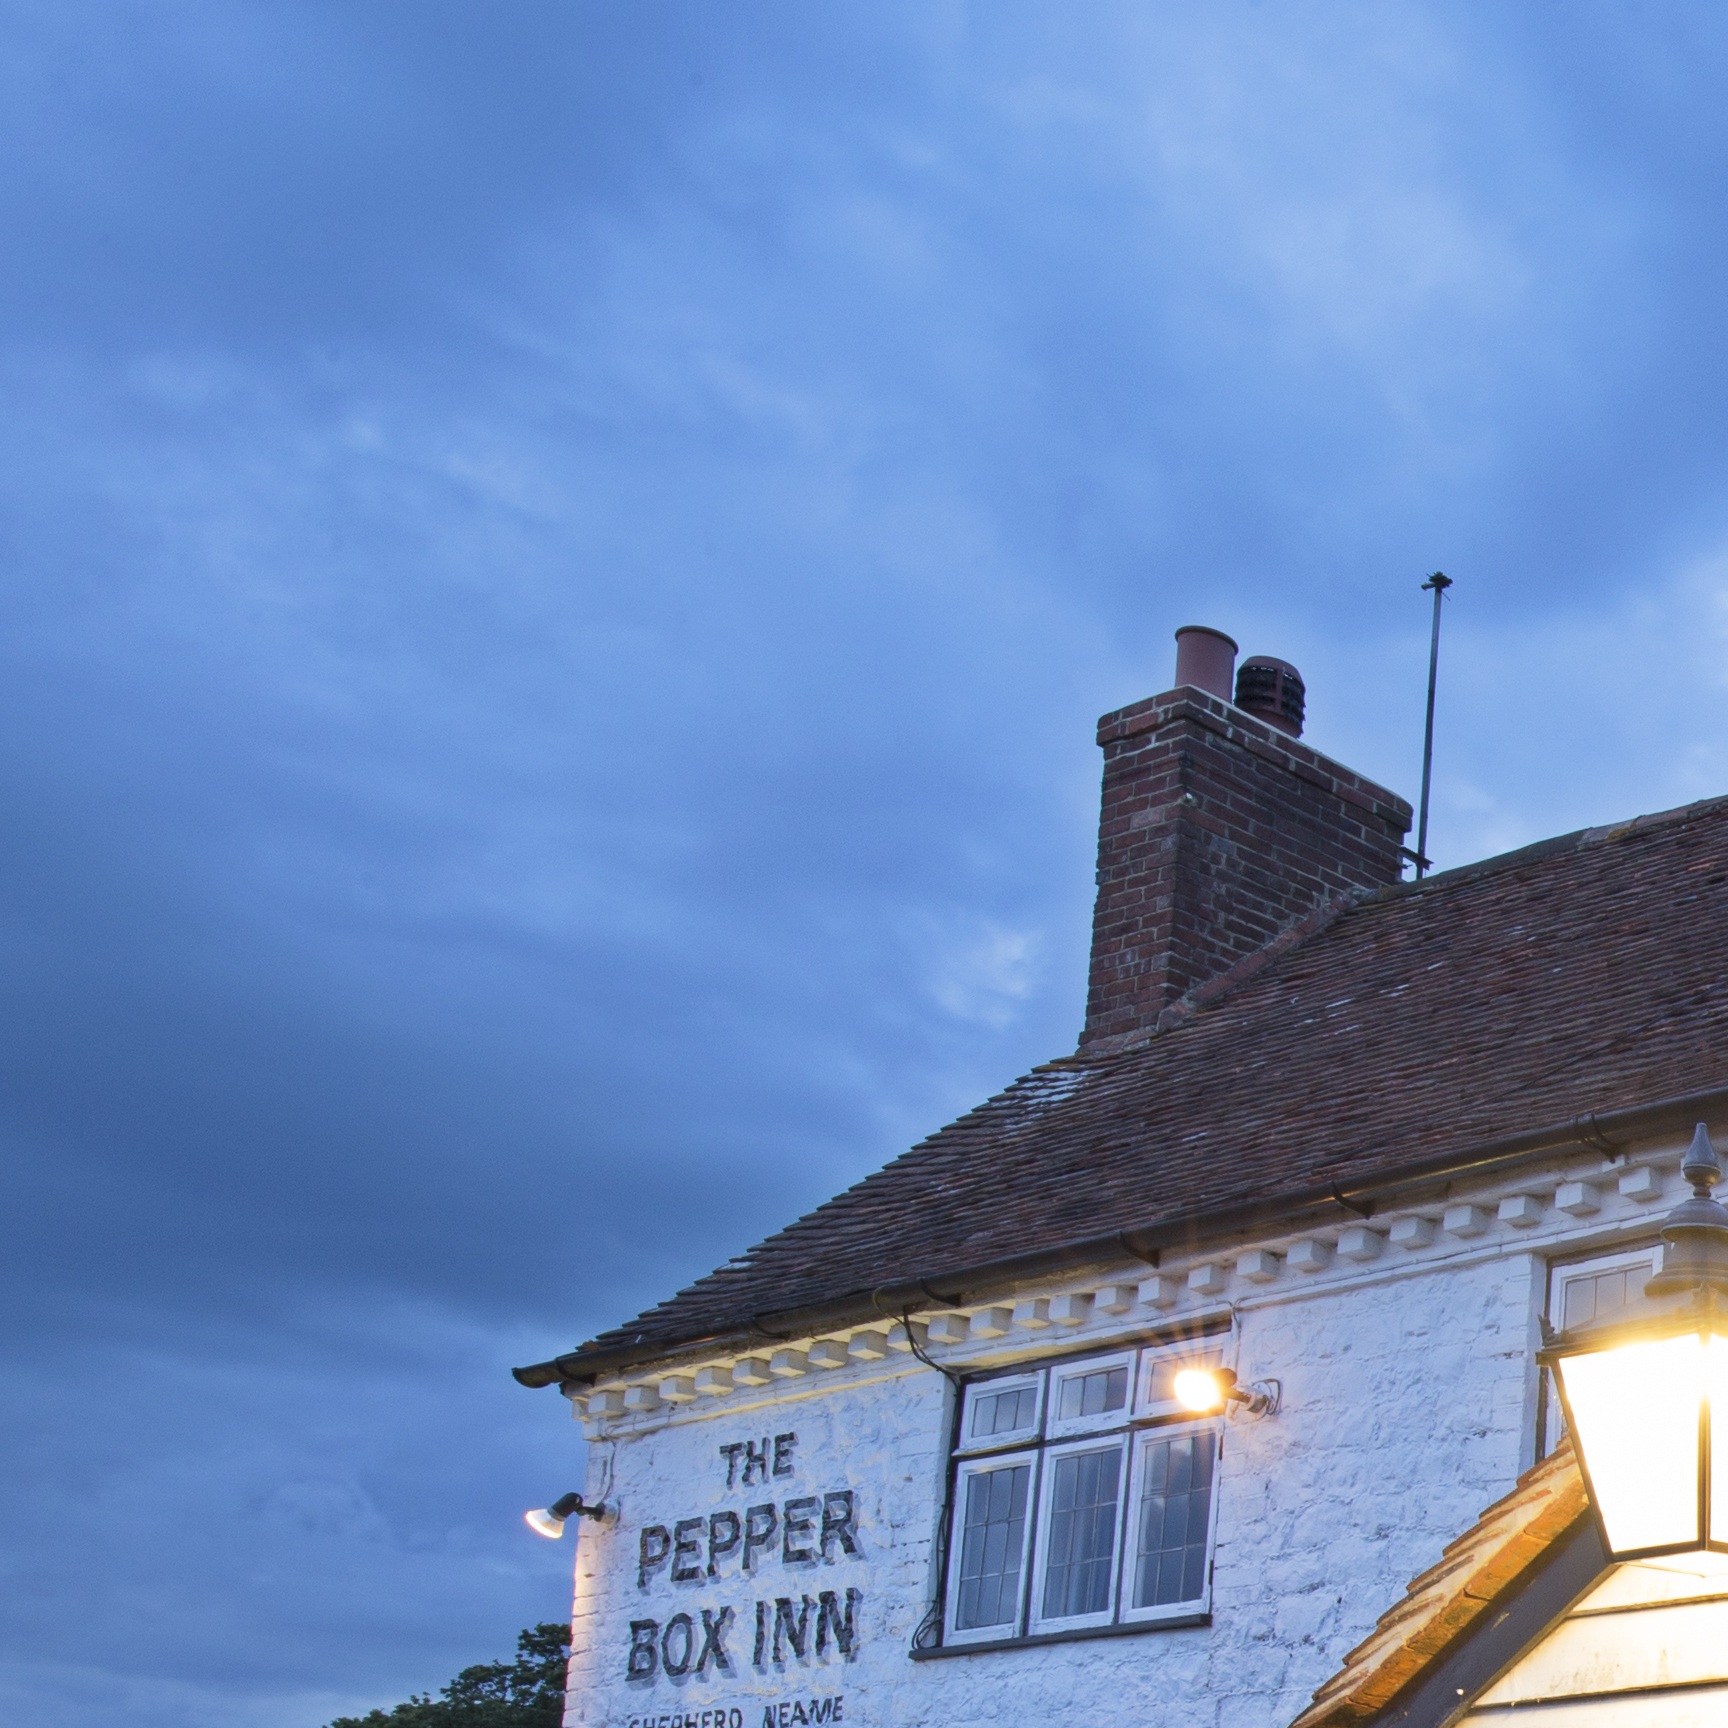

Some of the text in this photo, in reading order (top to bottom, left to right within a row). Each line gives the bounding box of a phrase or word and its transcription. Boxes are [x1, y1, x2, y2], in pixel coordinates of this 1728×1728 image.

[719, 1431, 799, 1491] THE
[636, 1488, 868, 1593] PEPPER
[624, 1586, 865, 1690] BOX INN
